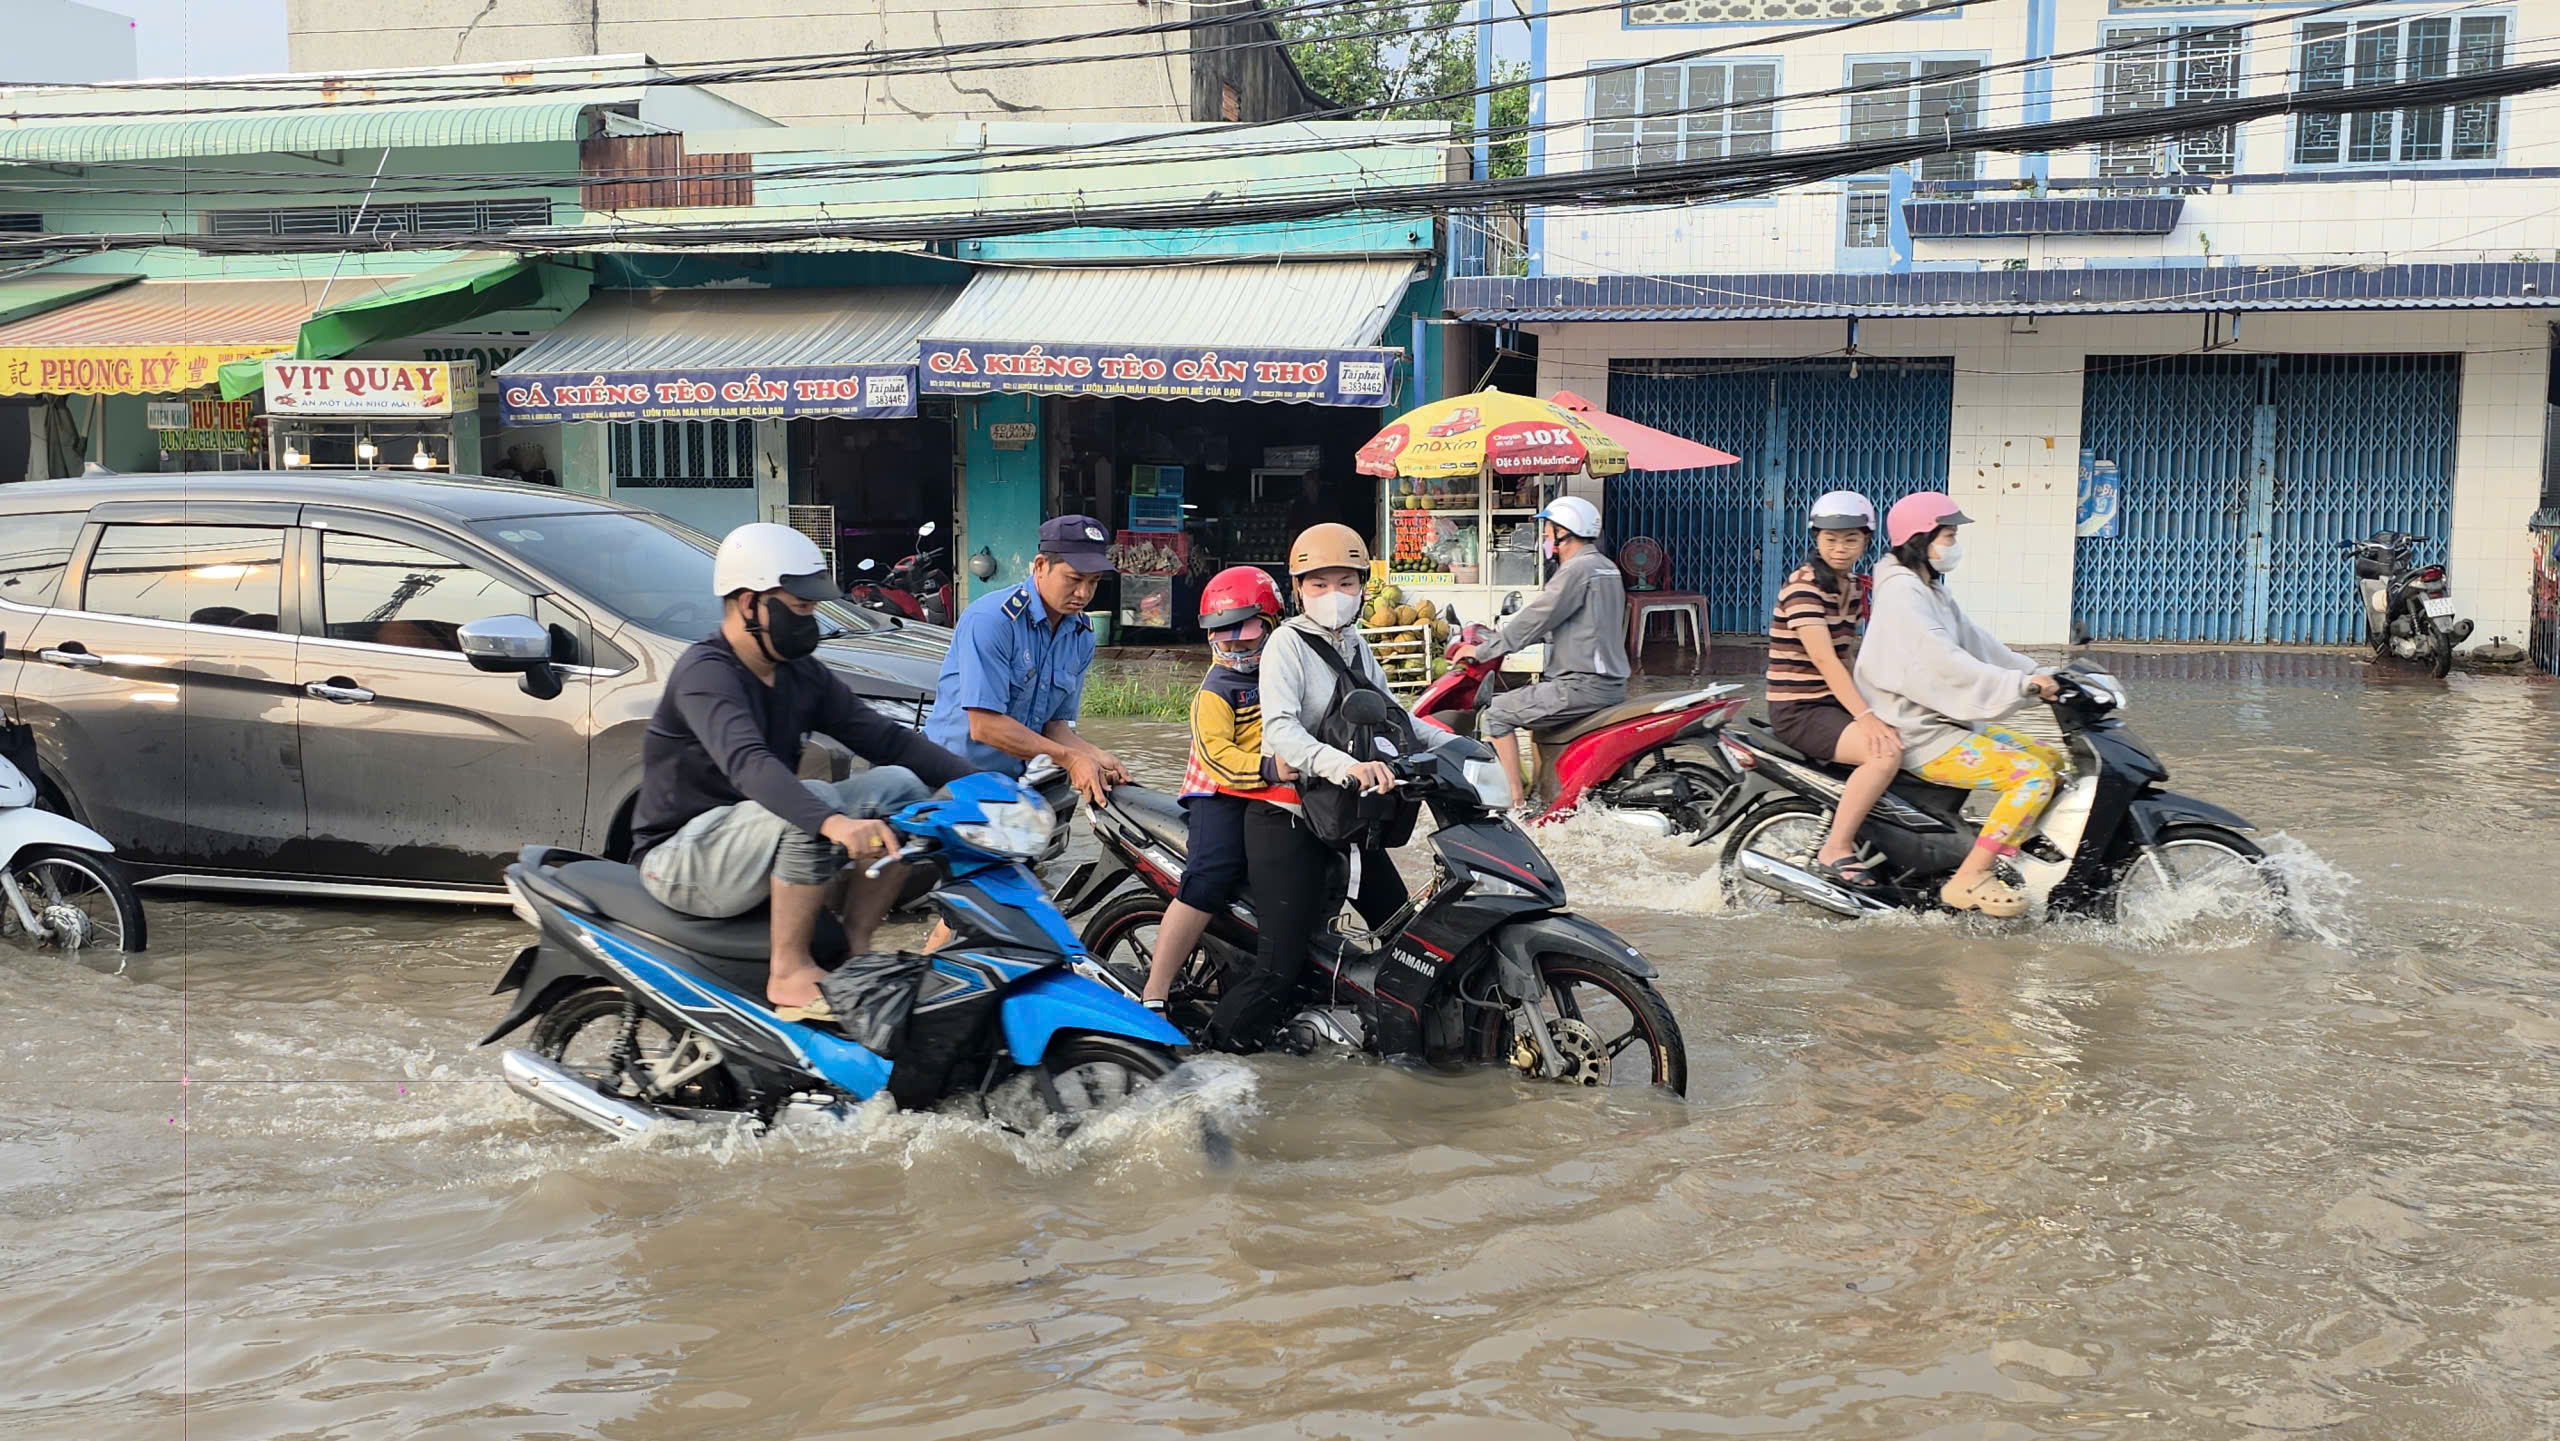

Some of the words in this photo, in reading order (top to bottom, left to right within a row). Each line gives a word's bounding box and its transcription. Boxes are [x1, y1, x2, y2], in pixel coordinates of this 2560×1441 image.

[8, 358, 32, 386] 記
[41, 359, 132, 387] PHONG
[140, 351, 180, 386] KÝ
[929, 348, 978, 374] CÁ
[984, 345, 1093, 377] KIỂNG
[1098, 353, 1167, 380] TÈO
[1173, 352, 1248, 382] CẦN
[1254, 360, 1328, 384] THƠ
[275, 366, 333, 396] VỊT
[344, 367, 438, 396] QUAY
[506, 382, 550, 407] CÁ
[553, 376, 651, 407] KIỂNG
[655, 379, 717, 403] TÈO
[721, 373, 789, 402] CẦN
[794, 376, 859, 401] THƠ
[1349, 382, 1382, 393] 3834462
[875, 395, 907, 405] 3834462
[1522, 428, 1573, 446] 10K
[1496, 457, 1513, 468] Đặt
[1521, 455, 1532, 466] tô
[1533, 454, 1580, 466] MaximCar
[1391, 947, 1436, 978] YAMAHA
